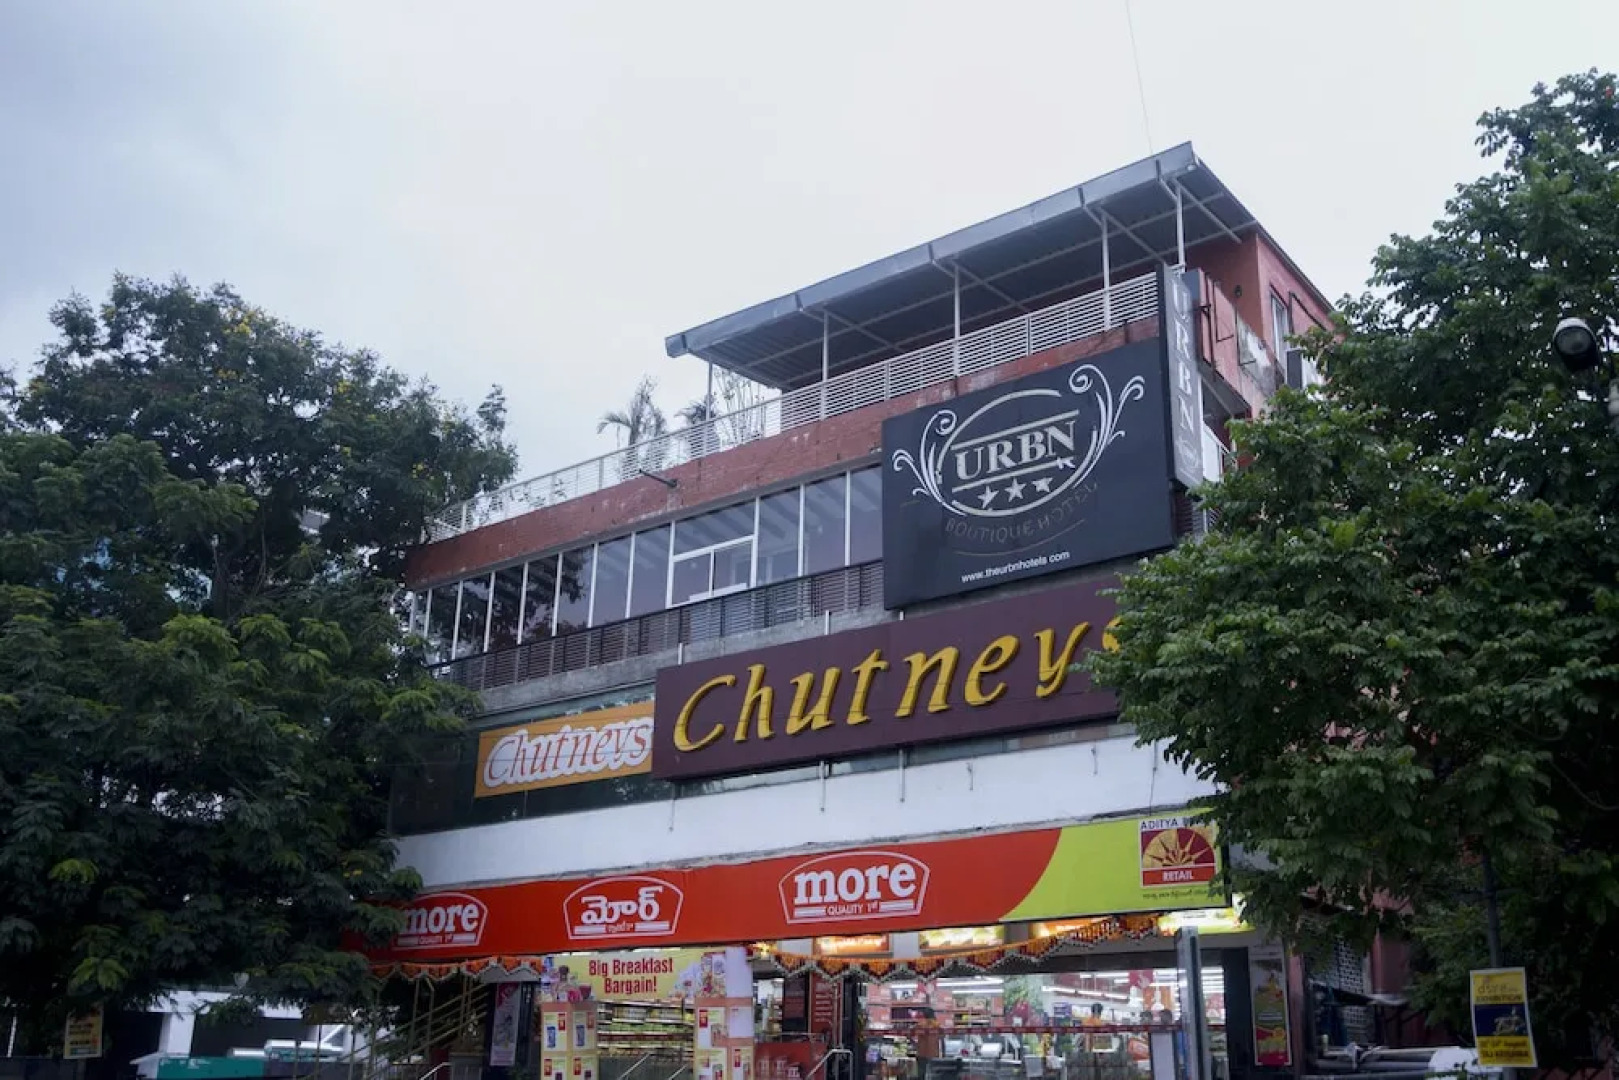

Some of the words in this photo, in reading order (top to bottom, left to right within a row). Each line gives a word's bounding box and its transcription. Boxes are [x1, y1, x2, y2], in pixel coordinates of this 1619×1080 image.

[955, 421, 1076, 480] URBN
[945, 517, 1034, 544] BOUTIQUE
[961, 551, 1070, 583] www.theurbnhotelscom
[485, 719, 654, 784] Chutneys
[1140, 818, 1178, 829] ADITYA
[794, 863, 917, 904] more
[1162, 870, 1194, 881] RETAIL
[581, 886, 663, 924] మోర్
[827, 904, 864, 916] QUALITY
[588, 960, 608, 977] Big
[612, 957, 673, 975] Breakfast
[604, 976, 658, 994] Bargain!
